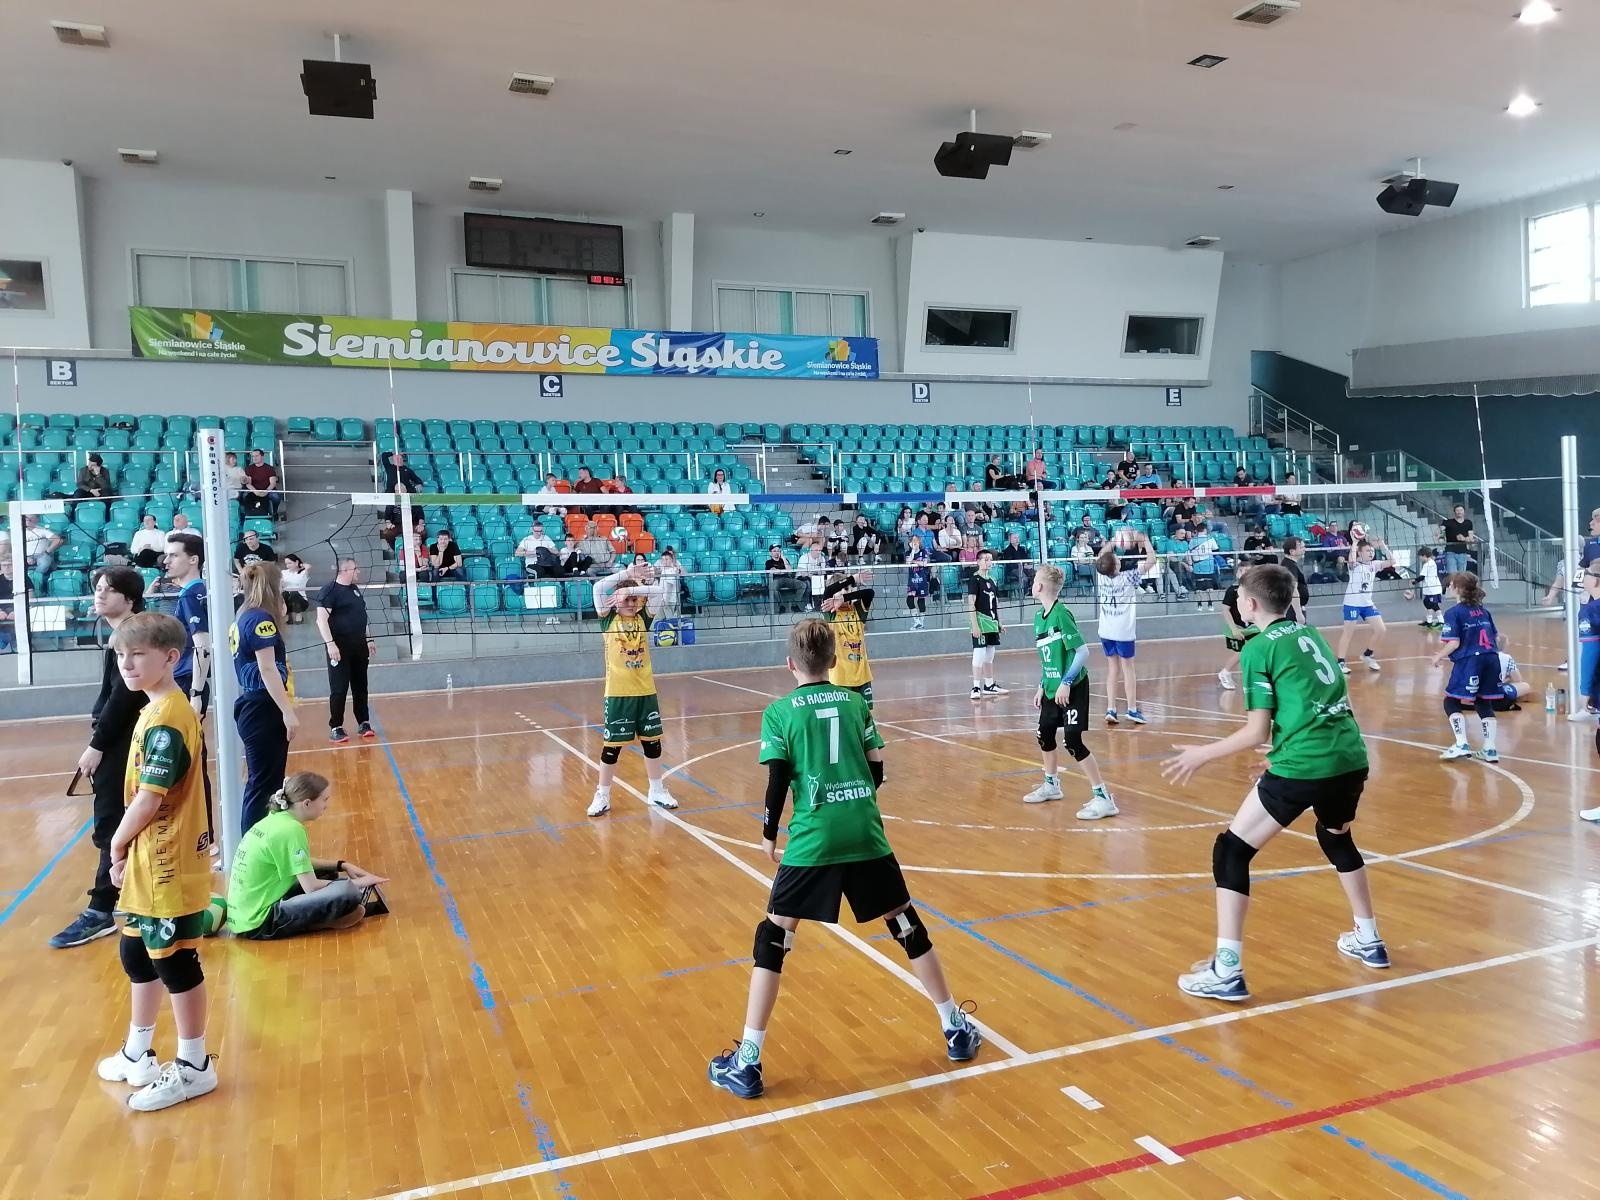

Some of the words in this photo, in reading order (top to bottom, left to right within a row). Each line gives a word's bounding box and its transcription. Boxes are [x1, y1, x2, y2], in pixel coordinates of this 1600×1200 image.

[149, 338, 212, 350] Siemianowice
[214, 339, 246, 351] Śląskie
[283, 322, 625, 366] Siemianowice
[631, 332, 786, 374] Śląskie
[52, 361, 72, 380] B
[807, 361, 850, 369] Siemianowice
[850, 361, 872, 370] Śląskie
[543, 375, 560, 393] C
[915, 383, 928, 398] D
[1170, 388, 1180, 402] E
[258, 624, 274, 634] HK
[1478, 629, 1493, 650] 4
[1041, 645, 1051, 662] 12
[1297, 635, 1335, 685] 3
[791, 695, 806, 708] KS
[807, 690, 851, 705] RACIBÓRZ
[1066, 709, 1079, 725] 12
[815, 707, 840, 764] 7
[826, 786, 872, 803] SCRIBA
[156, 803, 170, 868] HETMAN
